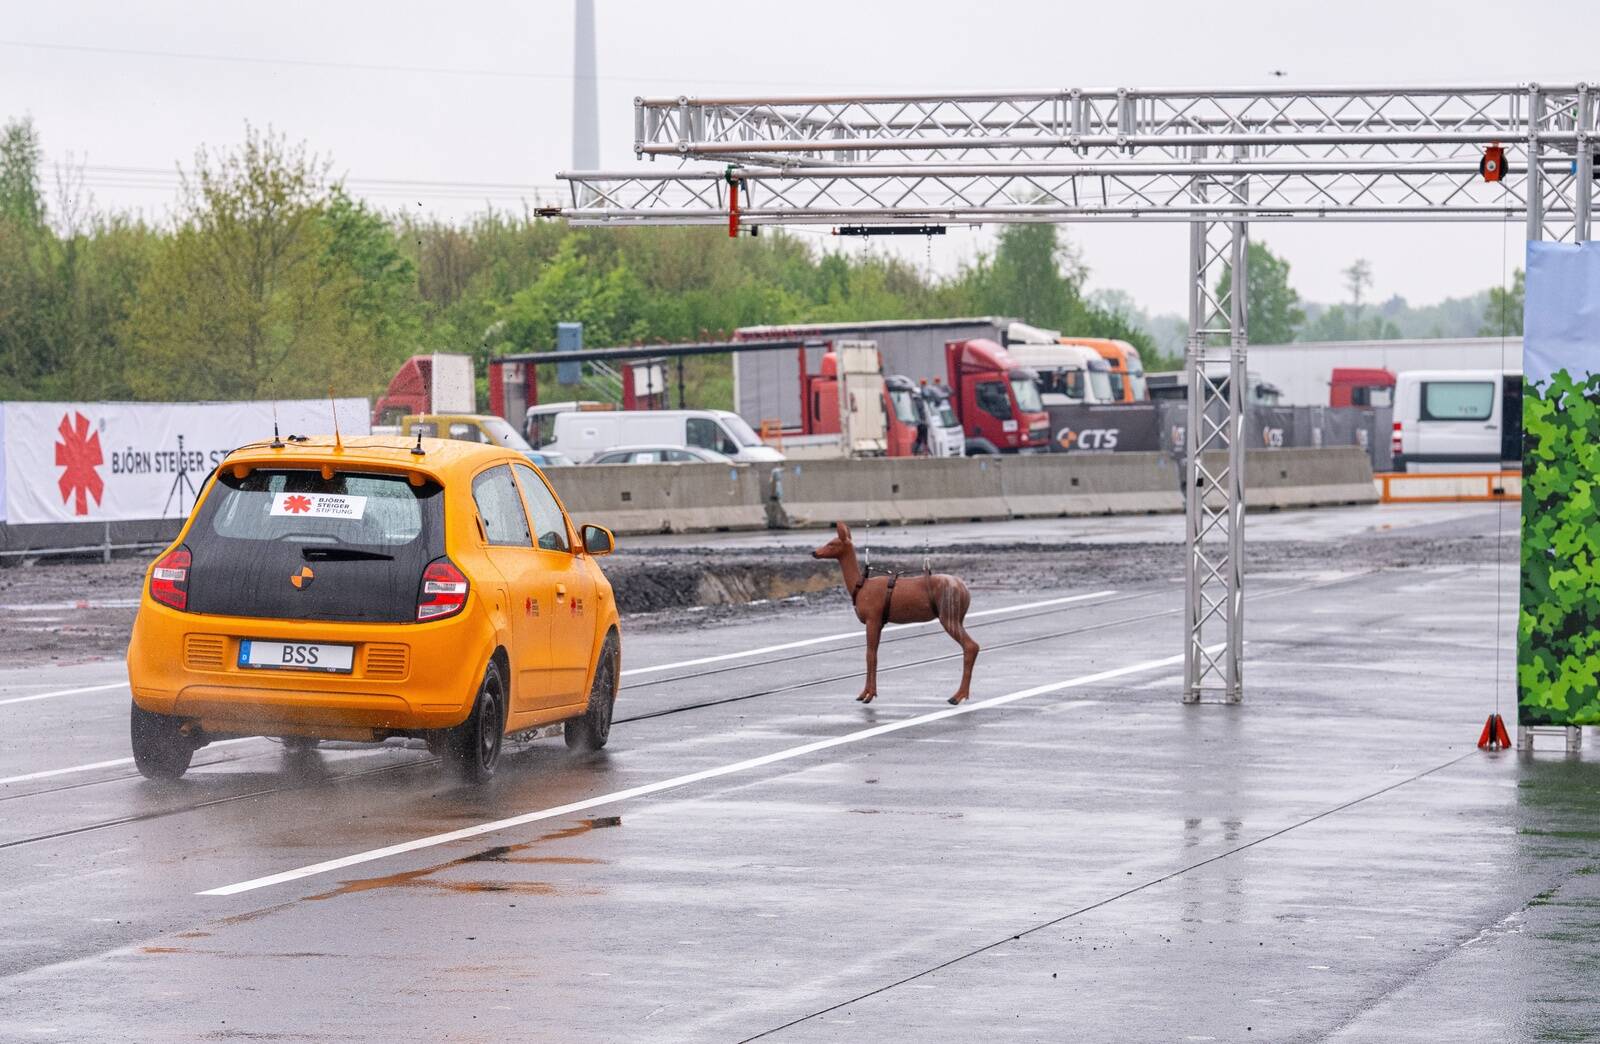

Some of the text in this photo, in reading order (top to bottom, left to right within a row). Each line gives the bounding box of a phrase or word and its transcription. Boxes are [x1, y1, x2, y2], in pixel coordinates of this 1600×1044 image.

[1077, 428, 1119, 449] CTS
[112, 446, 151, 474] BJÖRN
[155, 451, 205, 473] STEIGER
[318, 496, 346, 504] BJÖRN
[282, 645, 319, 665] BSS
